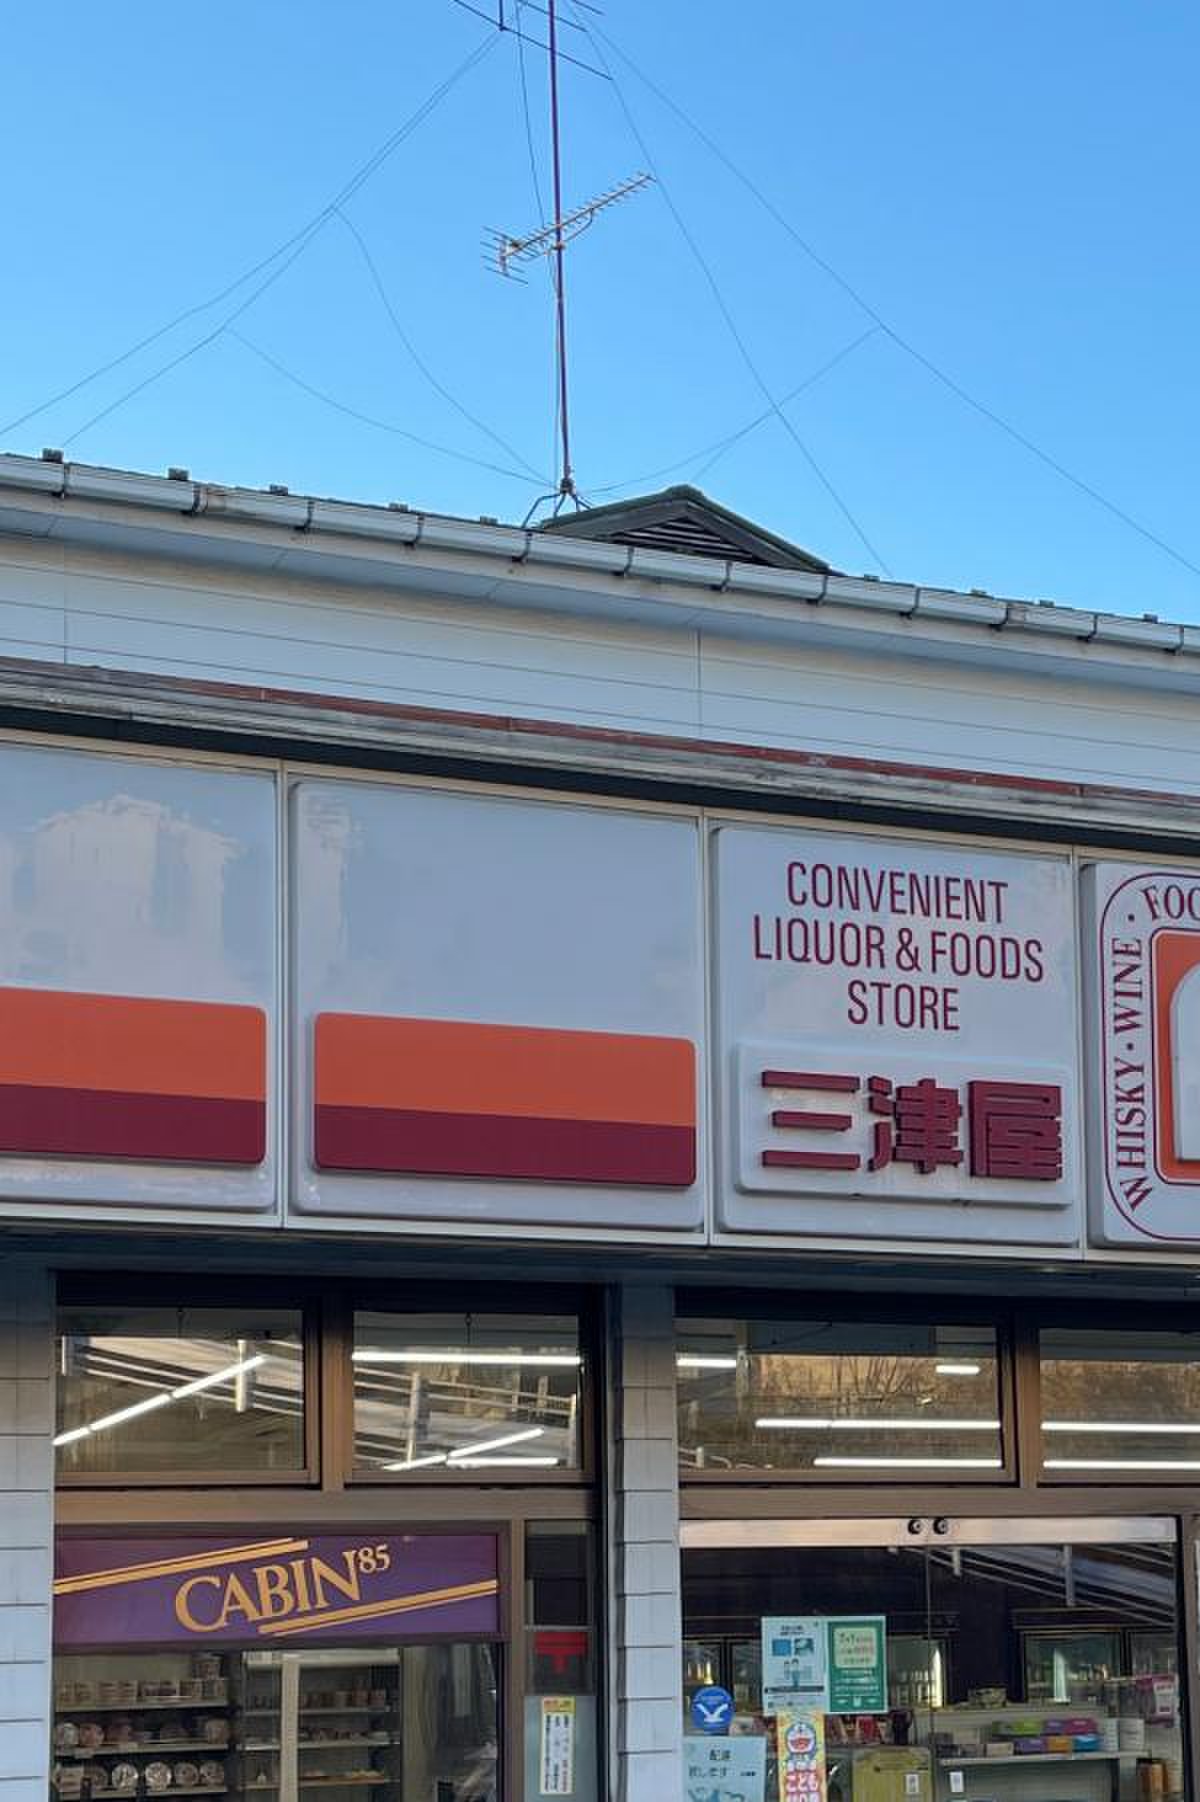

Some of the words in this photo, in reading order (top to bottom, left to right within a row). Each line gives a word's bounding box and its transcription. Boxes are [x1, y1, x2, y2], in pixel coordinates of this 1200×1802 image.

[786, 861, 1008, 923] CONVENIENT
[754, 914, 886, 969] LIQUOR
[896, 927, 922, 972] &
[930, 931, 1044, 983] FOODS
[1112, 937, 1143, 1034] WINE
[847, 979, 960, 1031] STORE
[761, 1070, 1063, 1181] 三津屋
[1114, 1056, 1153, 1211] WHISKY
[175, 1551, 361, 1633] CABIN
